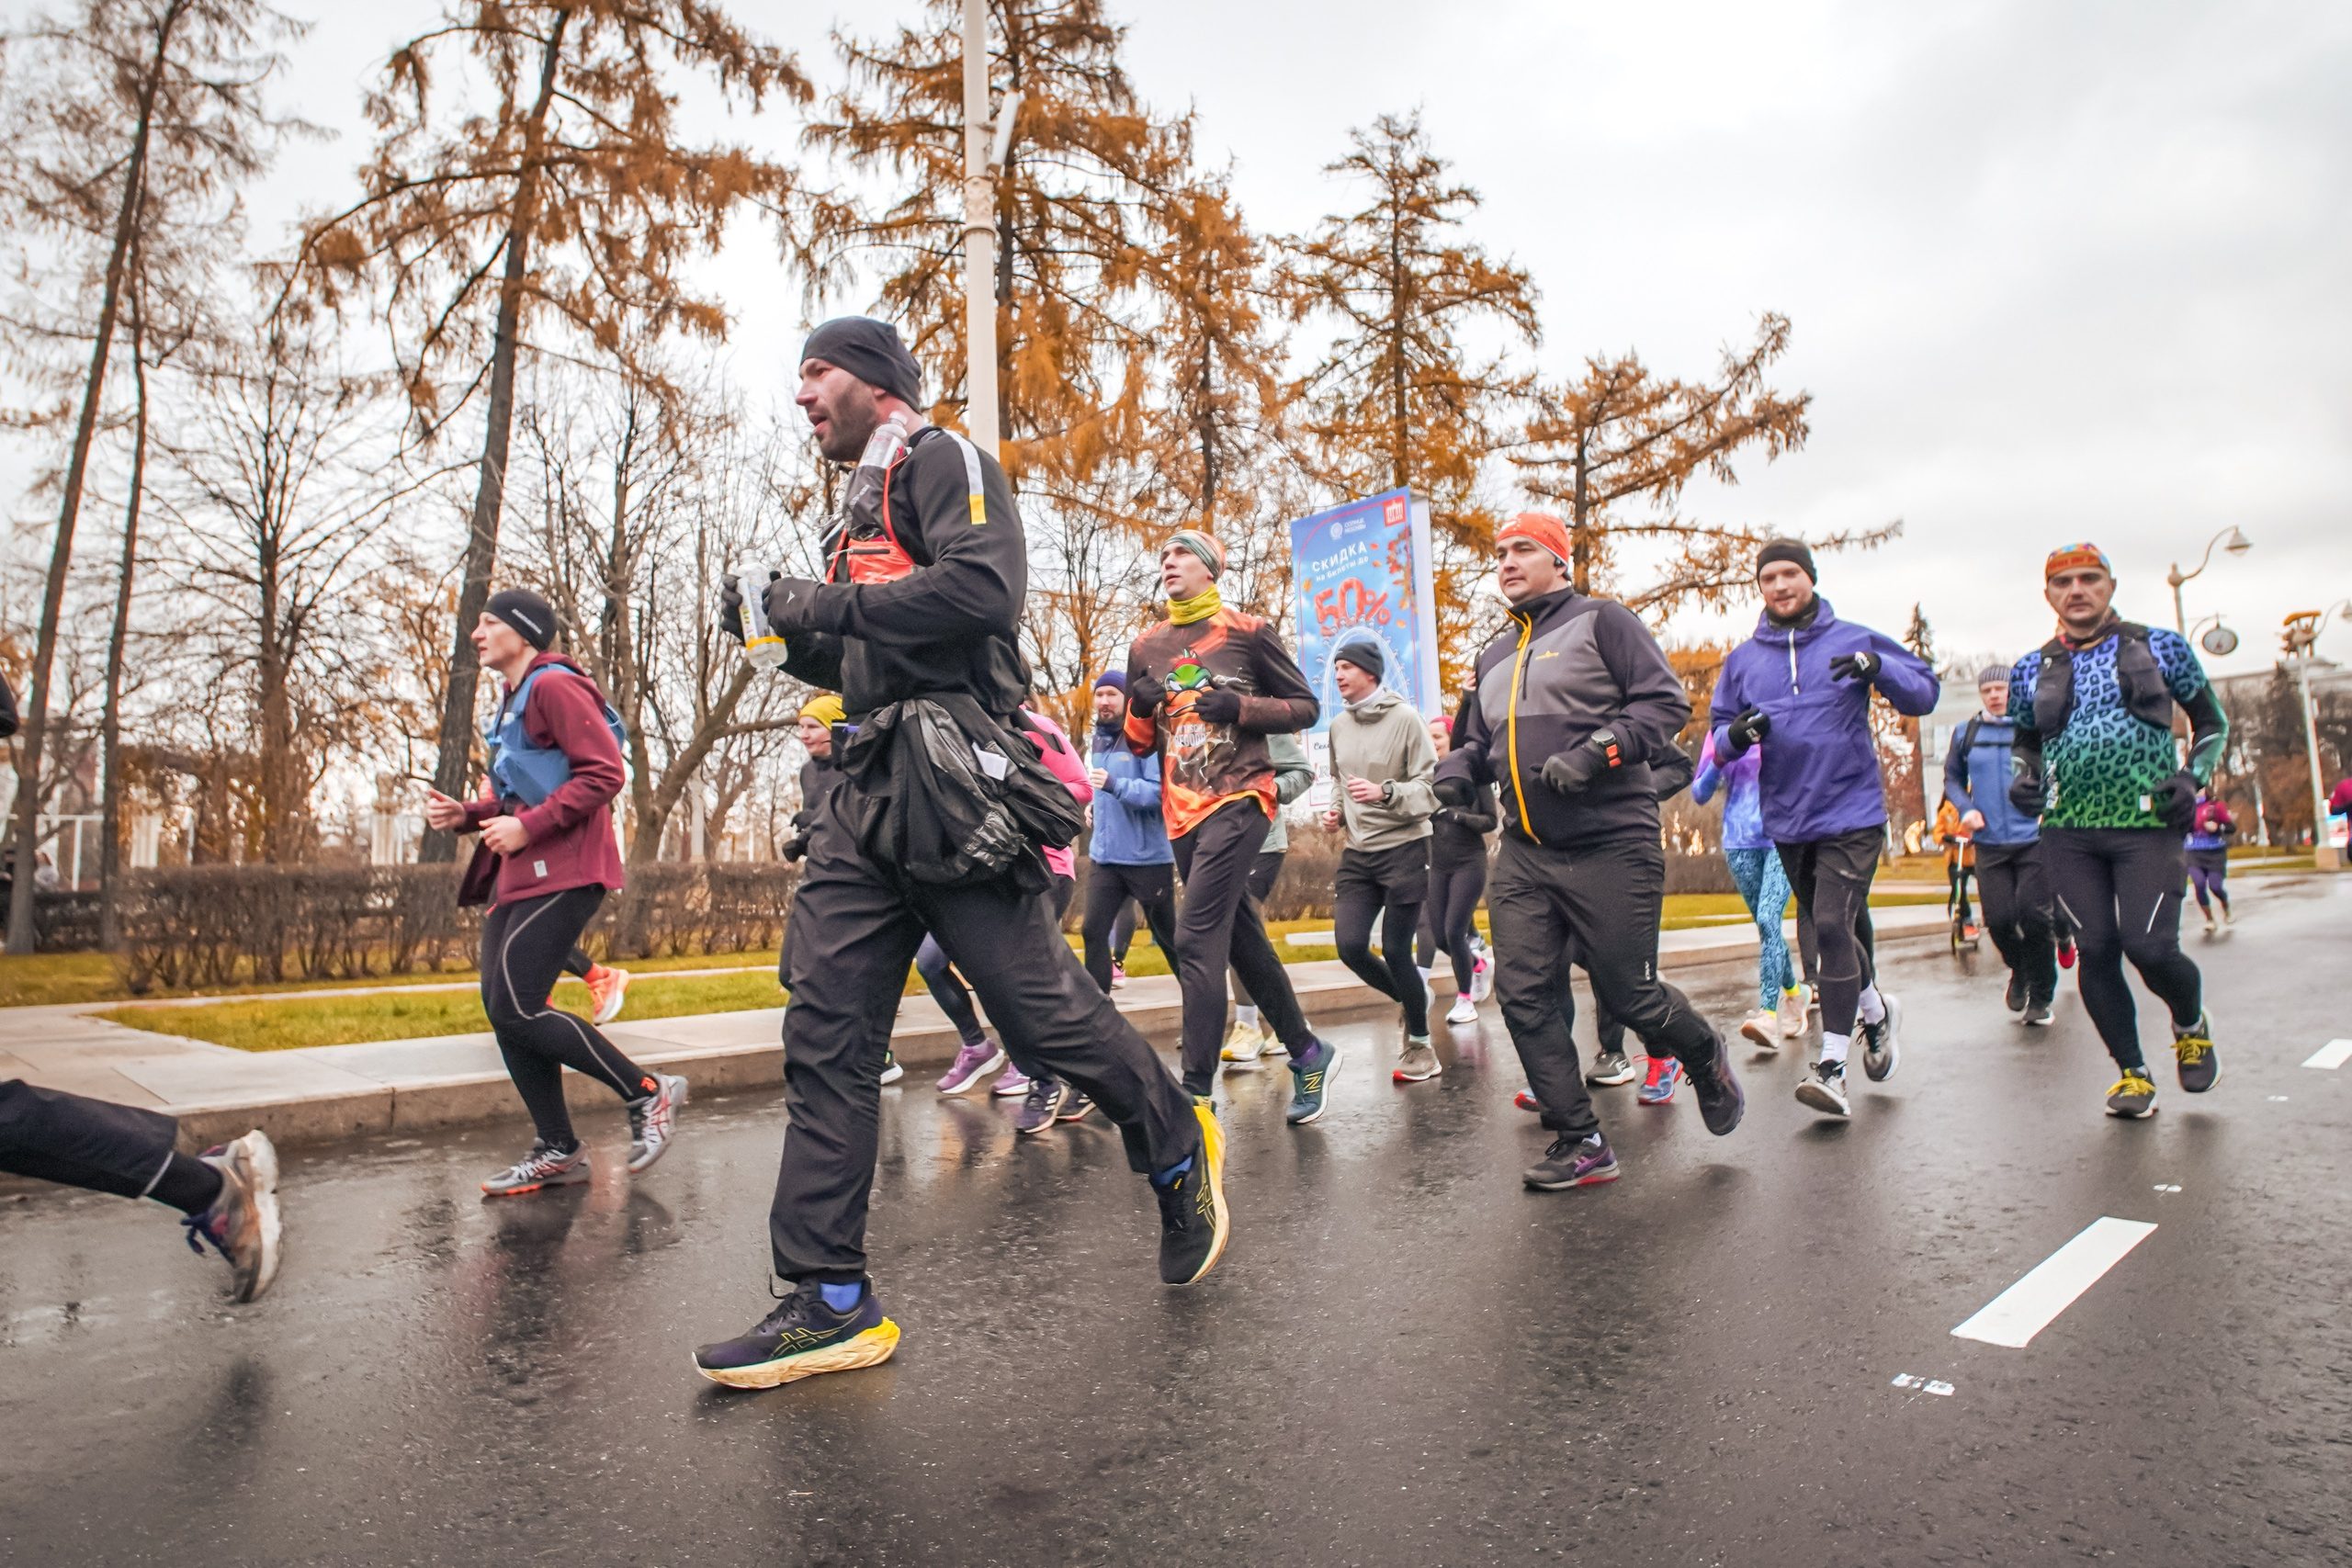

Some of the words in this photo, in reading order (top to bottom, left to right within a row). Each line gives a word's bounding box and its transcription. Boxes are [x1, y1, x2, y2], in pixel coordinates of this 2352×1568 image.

[1312, 541, 1367, 572] СКИДКА
[1316, 573, 1326, 581] на
[1327, 561, 1357, 578] билеты
[1358, 556, 1369, 565] до
[1314, 577, 1391, 637] 50%
